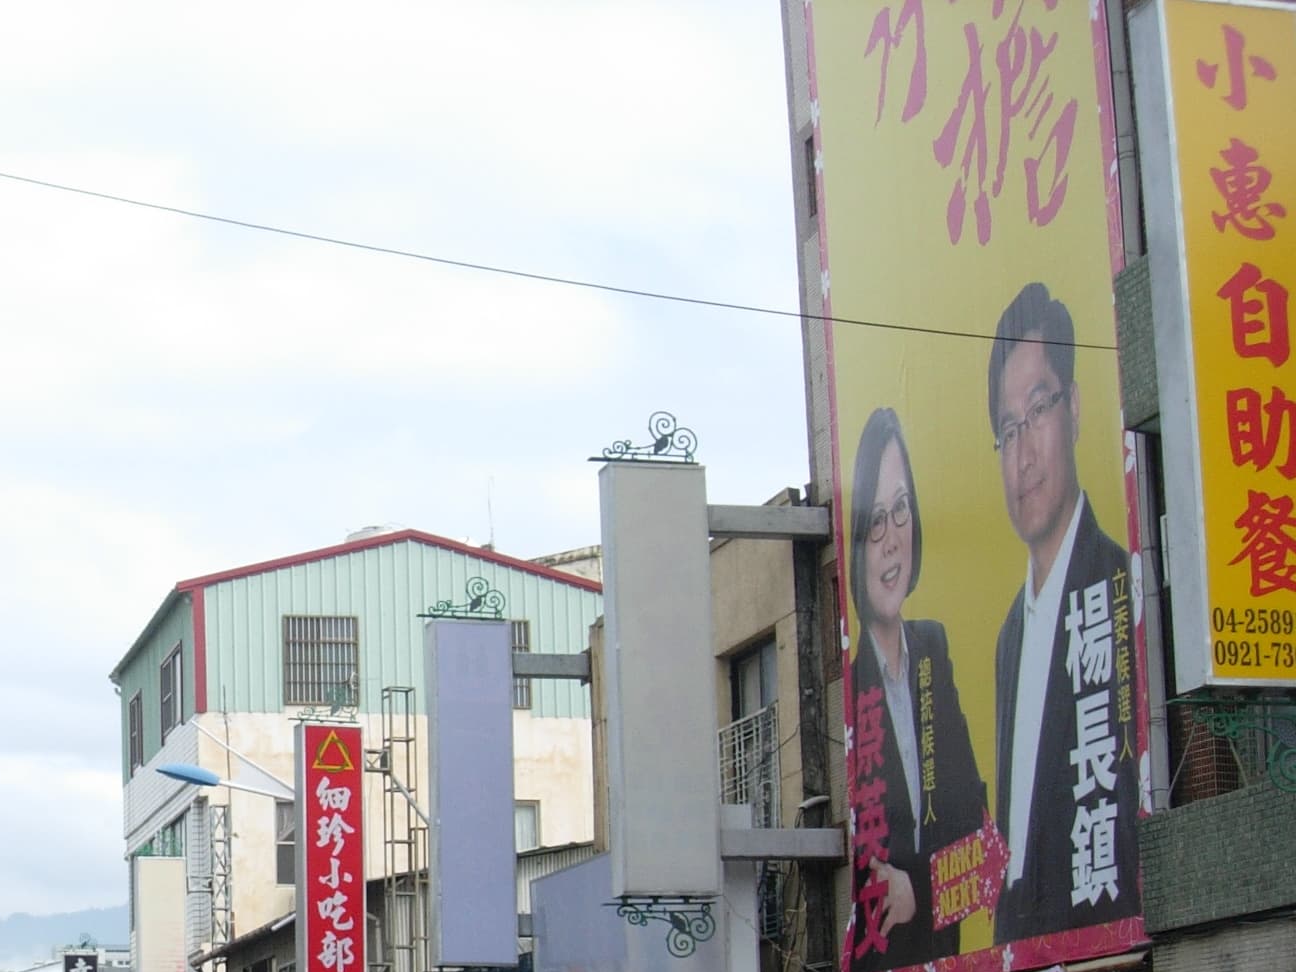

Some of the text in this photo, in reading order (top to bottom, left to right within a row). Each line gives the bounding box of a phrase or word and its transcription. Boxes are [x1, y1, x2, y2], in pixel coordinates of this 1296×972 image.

[1196, 24, 1296, 597] 小惠自助餐
[1065, 579, 1119, 908] 楊長鎮
[1112, 568, 1133, 763] 立委候選人
[1214, 640, 1296, 668] 0921-73
[855, 686, 891, 960] 蔡英文
